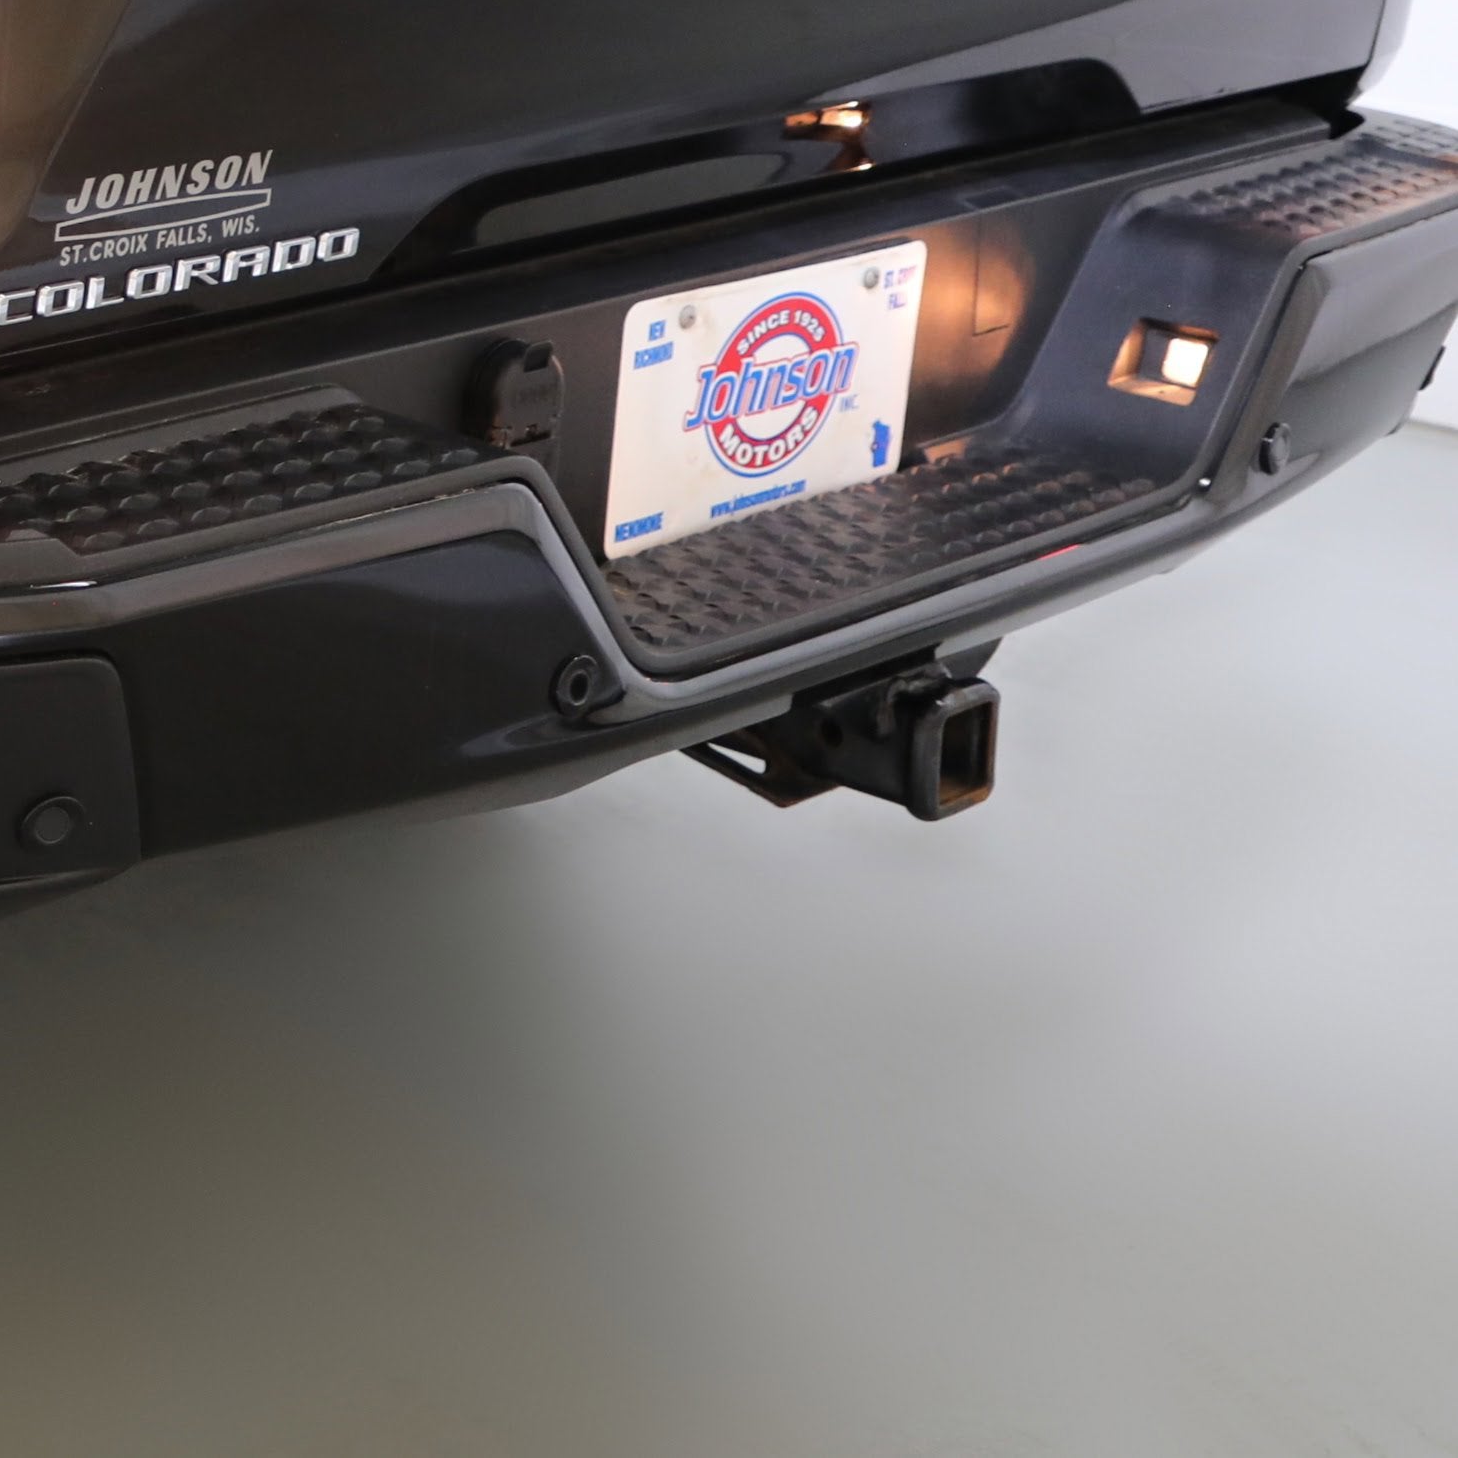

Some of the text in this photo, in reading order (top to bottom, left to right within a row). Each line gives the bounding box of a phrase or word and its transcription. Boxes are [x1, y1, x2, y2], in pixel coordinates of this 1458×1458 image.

[65, 149, 274, 215] JOHNSON
[155, 222, 212, 249] FALLS,
[221, 215, 261, 238] WIS.
[736, 309, 826, 355] SINCE 1925
[684, 343, 859, 431] Johnson
[719, 406, 819, 467] MOTORS
